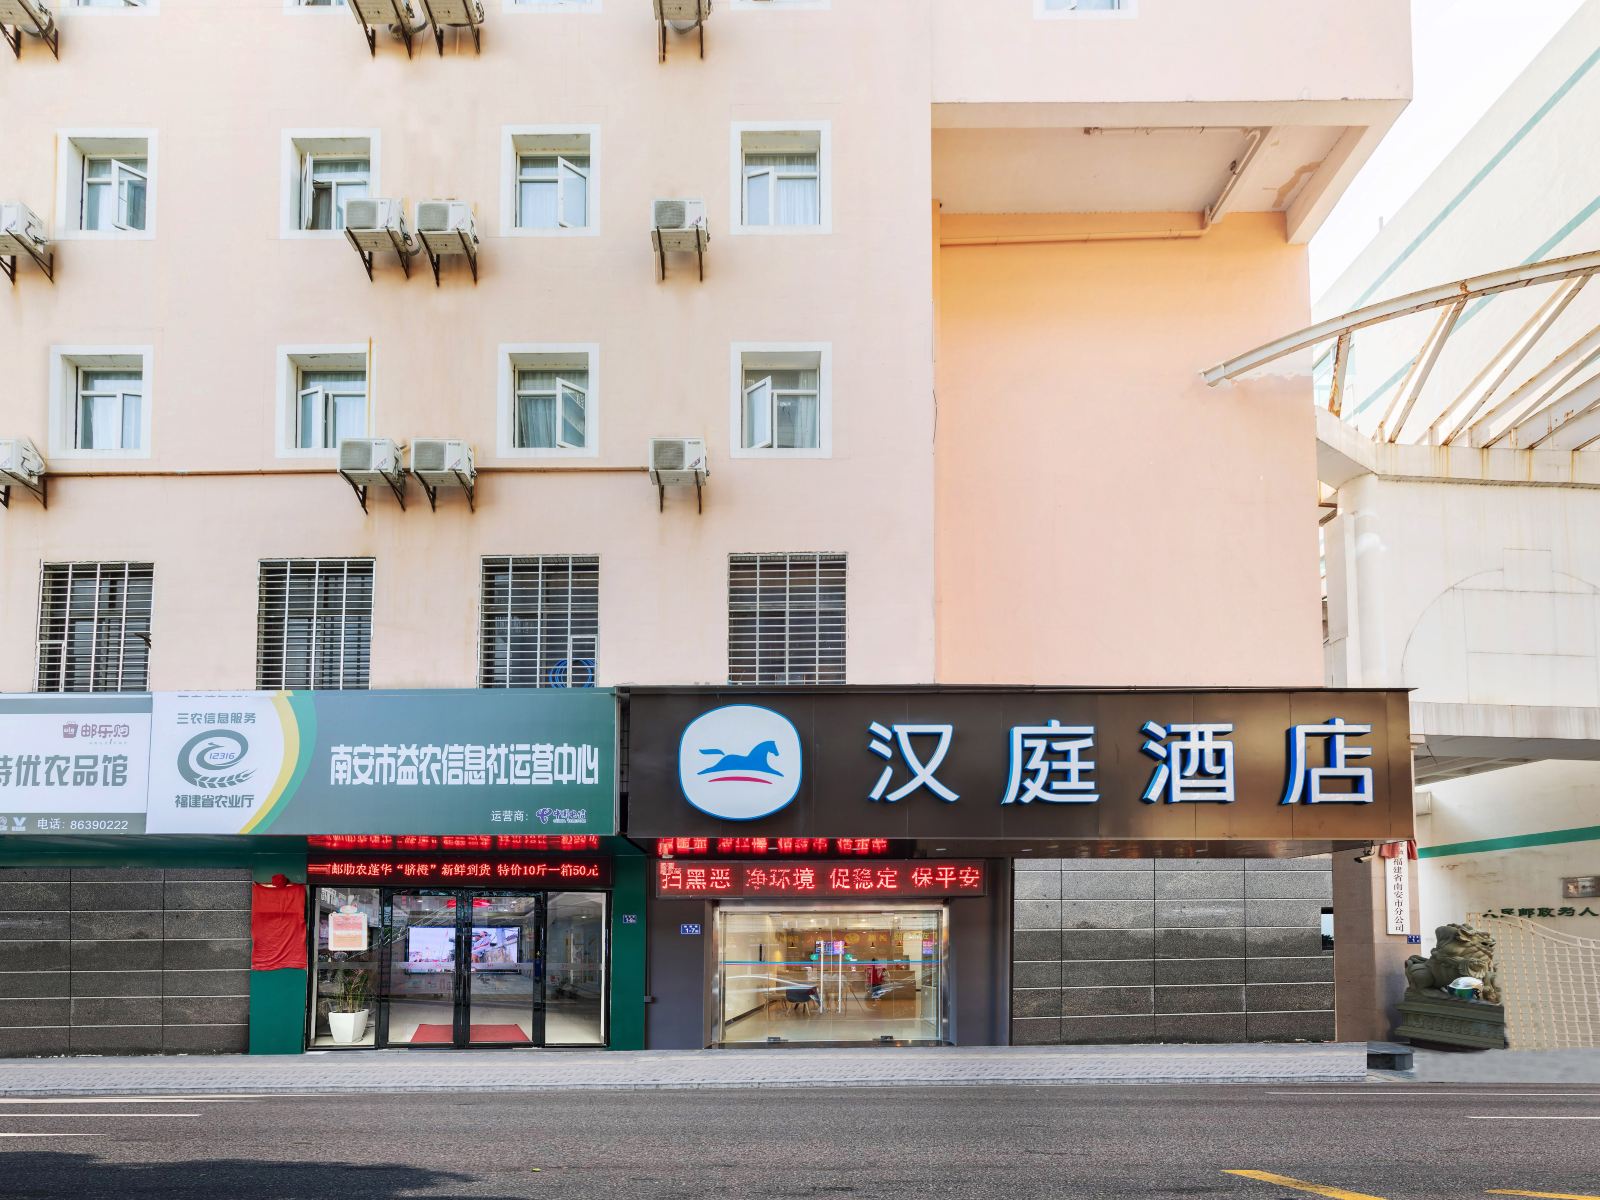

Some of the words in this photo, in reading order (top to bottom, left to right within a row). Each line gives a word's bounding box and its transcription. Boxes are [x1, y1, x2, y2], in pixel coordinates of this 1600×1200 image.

[177, 712, 256, 724] 三农信息服务
[81, 723, 130, 738] 邮乐购
[209, 752, 236, 760] 12316
[868, 718, 1375, 805] 汉庭酒店
[330, 743, 599, 785] 南安市益农信息社运营中心
[175, 794, 255, 808] 福建省农业厅
[70, 820, 129, 830] 86390222
[745, 867, 816, 890] 净环境
[829, 867, 898, 889] 促稳定
[911, 866, 981, 889] 保平安
[1393, 842, 1404, 933] 福建省南安市分公司
